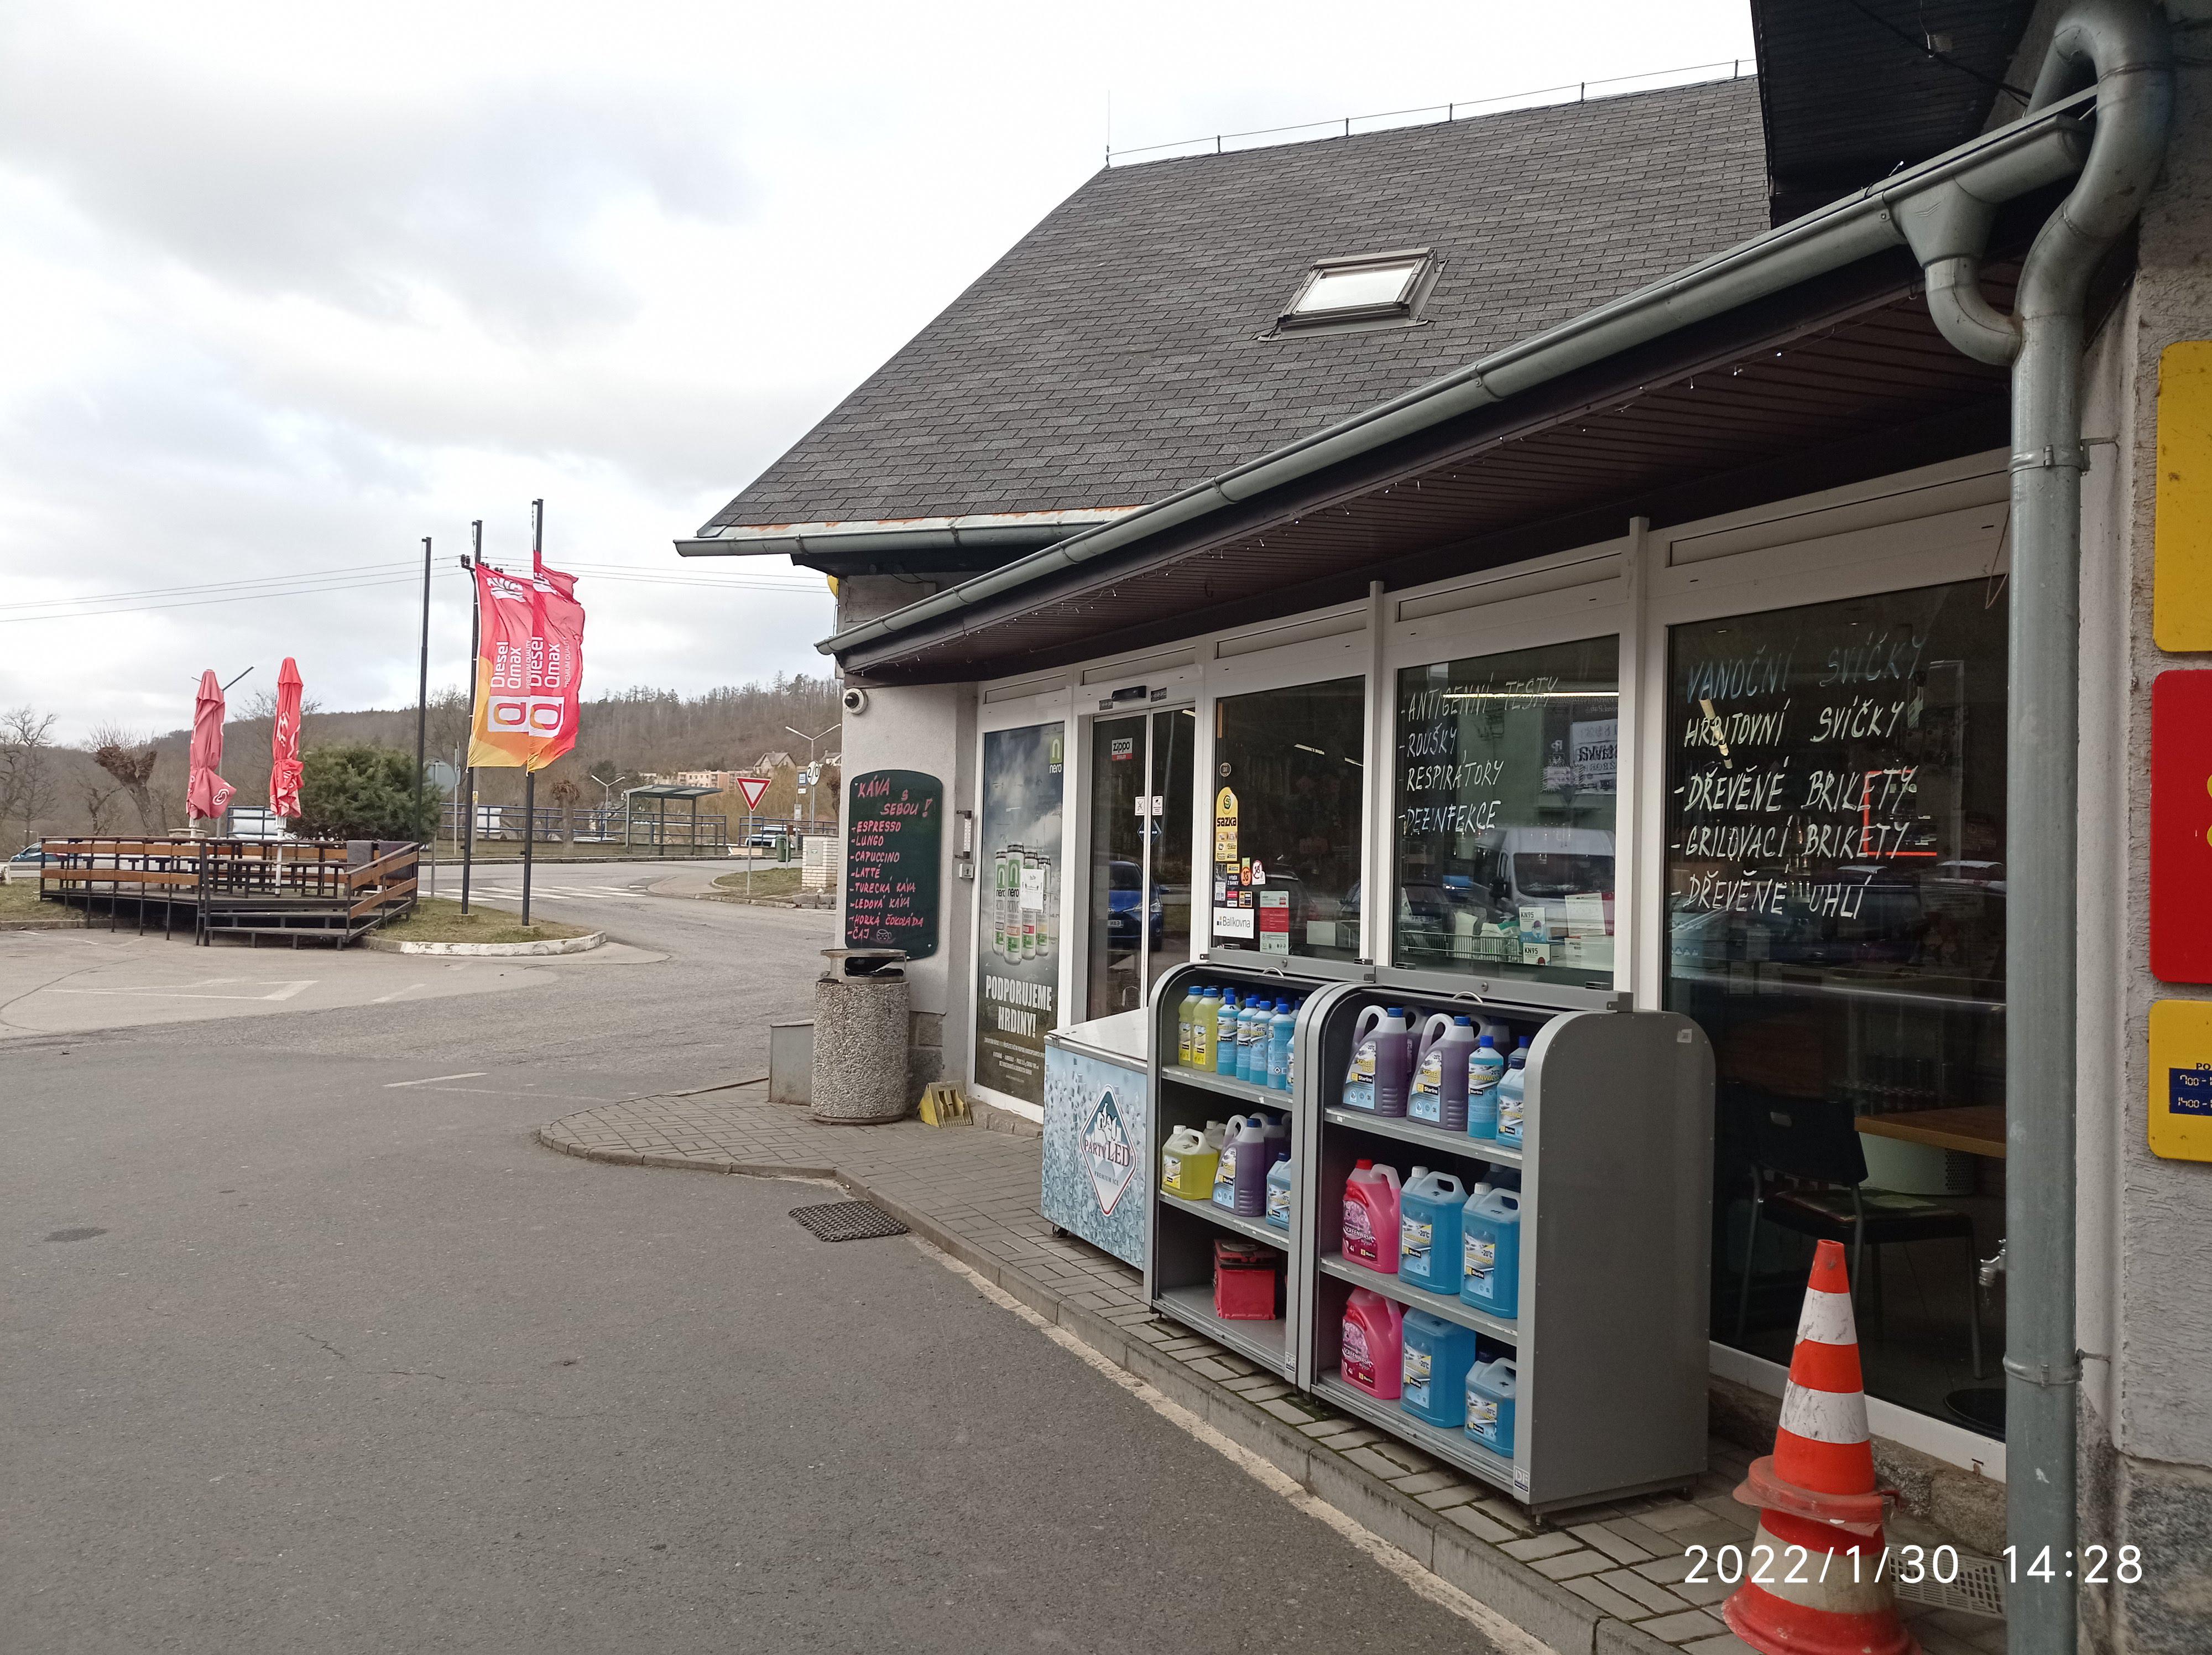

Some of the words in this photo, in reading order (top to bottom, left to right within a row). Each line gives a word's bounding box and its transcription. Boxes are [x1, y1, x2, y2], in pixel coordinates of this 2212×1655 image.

[491, 642, 509, 688] Diesel
[507, 647, 521, 689] Qmax
[544, 643, 560, 688] Qmax
[1820, 631, 1927, 687] SVÍČKY
[1504, 676, 1559, 710] TESTY
[1809, 695, 1905, 743] SVÍČKY
[1050, 764, 1062, 773] nero
[858, 775, 890, 798] KÁVA
[1801, 764, 1919, 815] BRIKETY
[1802, 821, 1910, 860] BRIKETY
[889, 894, 910, 909] KÁVA
[896, 878, 916, 893] KÁVA
[1008, 888, 1019, 897] nero
[1223, 916, 1250, 928] Balíkovna
[985, 975, 1052, 1011] PODPORUJEME
[998, 1006, 1036, 1038] HRDINY!
[1094, 1171, 1112, 1183] PREMIUM
[1344, 1226, 1373, 1241] SCREENWASH
[1343, 1347, 1371, 1365] SCREENWASH
